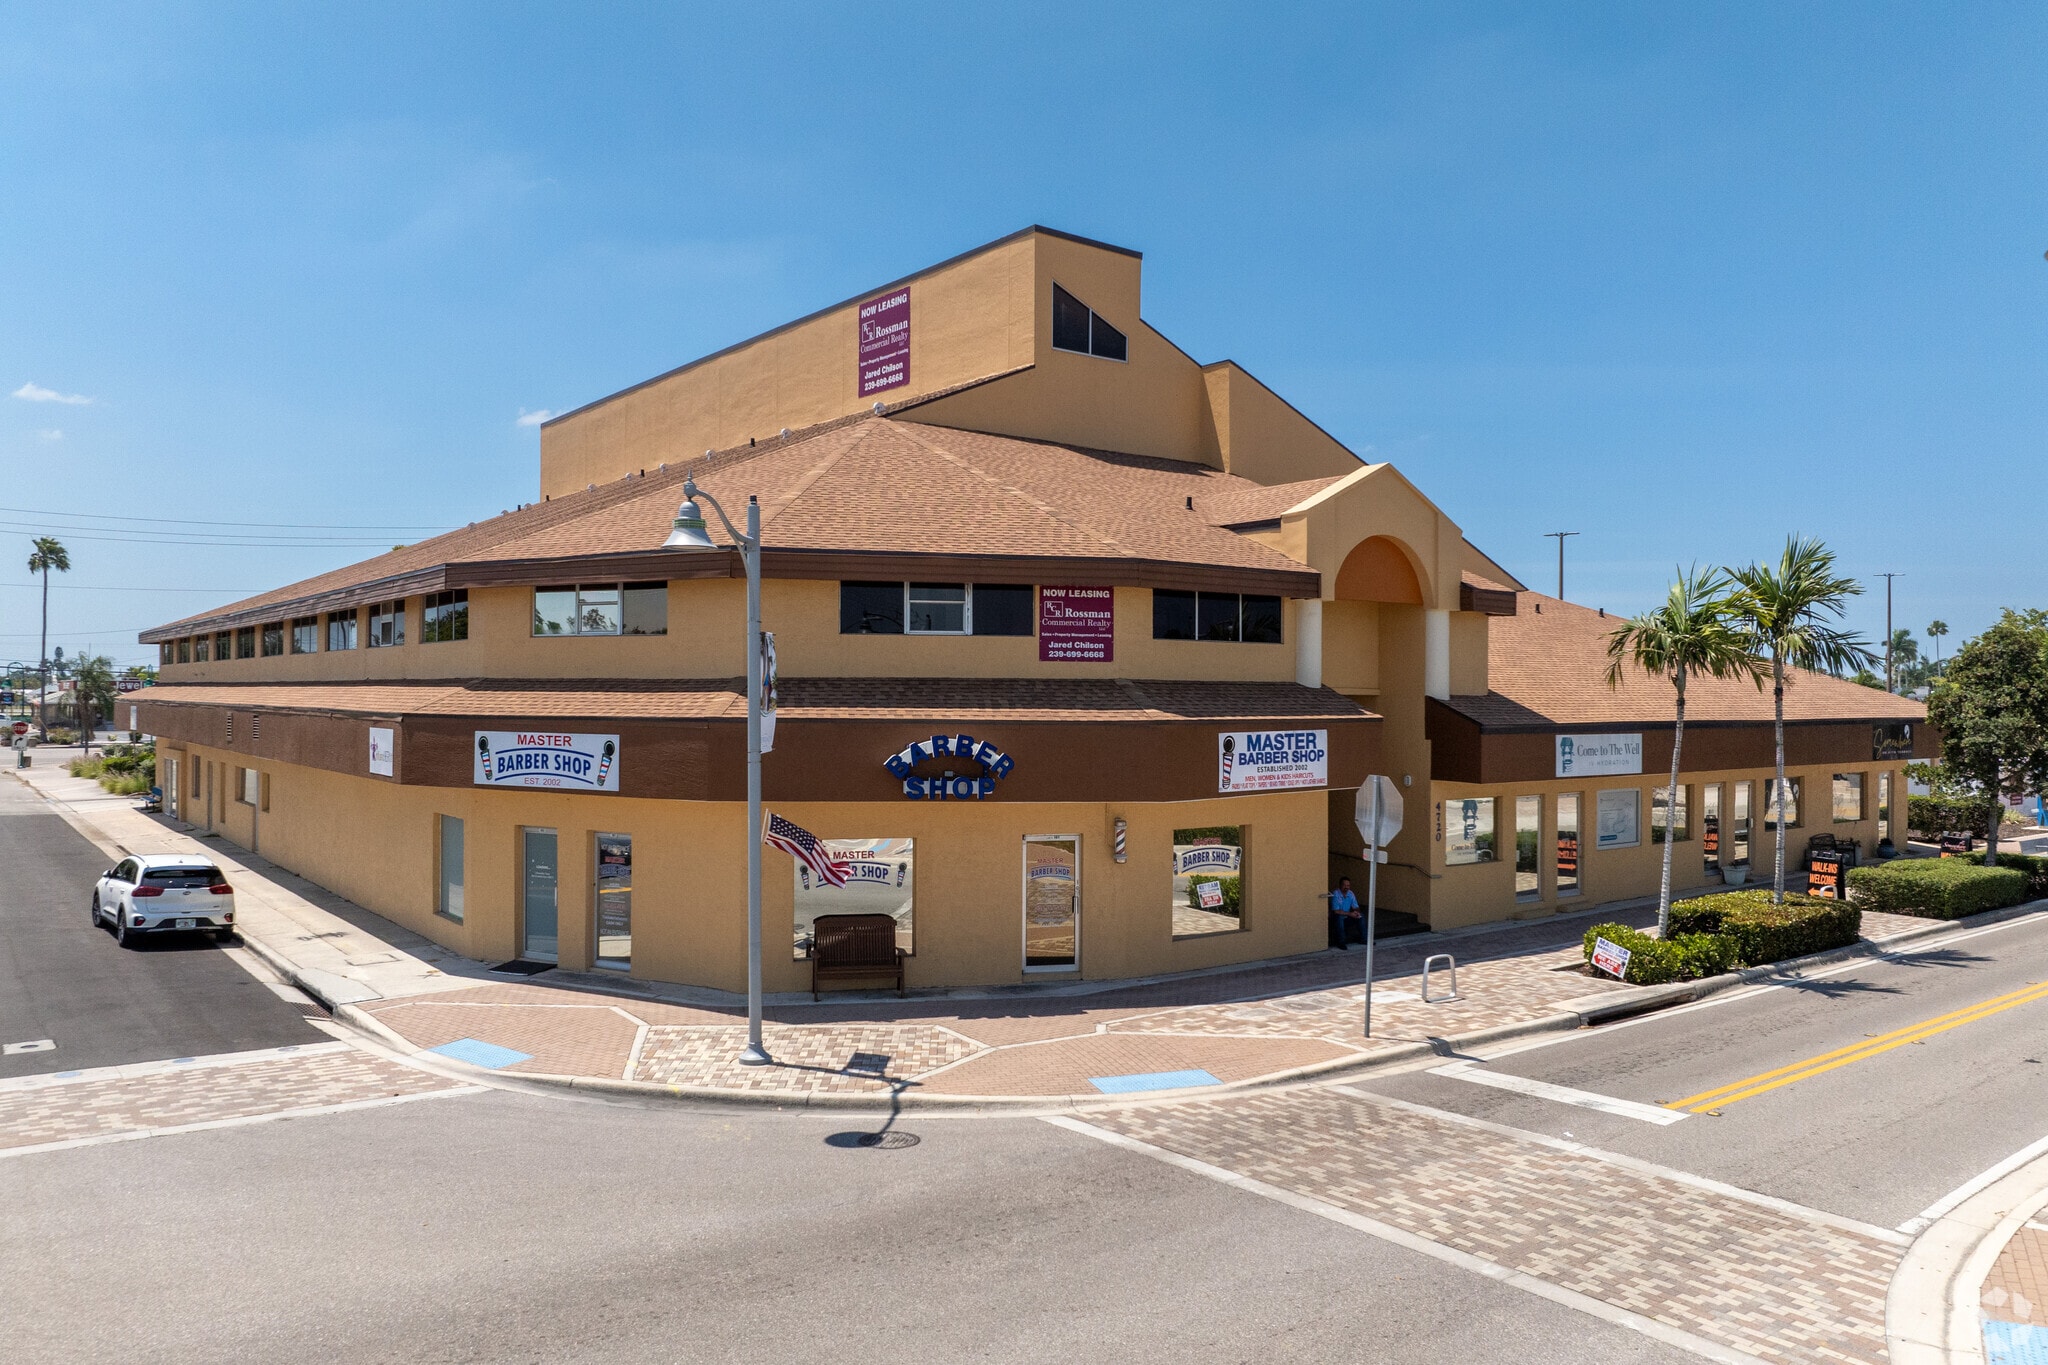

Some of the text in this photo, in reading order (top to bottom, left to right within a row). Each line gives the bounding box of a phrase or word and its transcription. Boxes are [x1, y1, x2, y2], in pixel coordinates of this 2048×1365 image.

[861, 293, 907, 319] NOW LEASING
[875, 320, 909, 338] Rossman
[864, 362, 904, 380] Jared Chilson
[1043, 589, 1110, 598] NOW LEASING
[1065, 608, 1111, 618] Rossman
[1041, 618, 1111, 628] Commercial Realty
[1074, 641, 1104, 649] Chilson
[517, 734, 572, 747] MASTER
[1246, 732, 1317, 752] MASTER
[1577, 742, 1640, 756] Come to The Well
[883, 733, 1015, 780] BARBER
[1238, 749, 1325, 766] BARBER SHOP
[497, 753, 591, 776] BARBER SHOP
[1256, 765, 1293, 774] ESTABLISHED
[543, 778, 561, 786] 2002
[904, 776, 995, 800] SHOP
[833, 850, 875, 860] MASTER
[1182, 851, 1230, 868] BARBER SHOP
[862, 865, 889, 880] SHOP
[1031, 866, 1070, 878] BARBER SHOP
[1811, 861, 1838, 874] WALK-INS
[1809, 873, 1837, 886] WELCOME
[1598, 939, 1629, 957] MASTER
